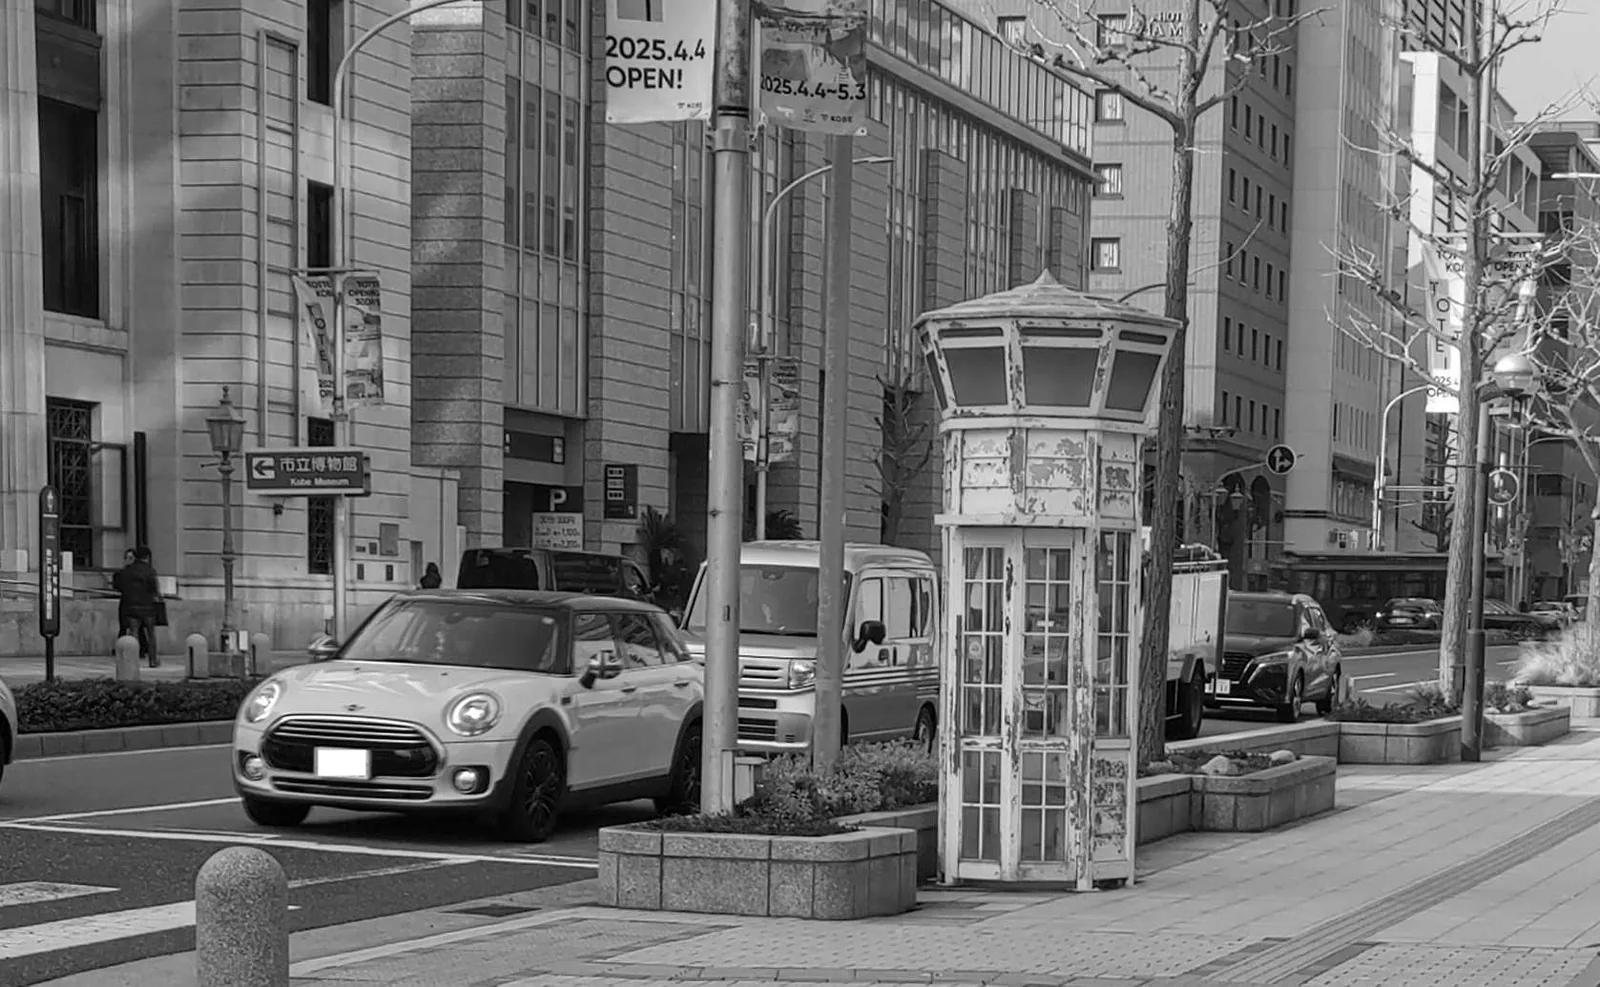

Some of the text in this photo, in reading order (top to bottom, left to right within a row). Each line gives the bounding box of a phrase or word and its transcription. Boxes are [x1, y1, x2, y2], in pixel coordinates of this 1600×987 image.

[605, 36, 705, 61] 2025.4.4
[605, 66, 683, 89] OPEN!
[279, 456, 358, 472] 市立博物館
[290, 478, 312, 486] Kobe
[549, 488, 567, 512] P
